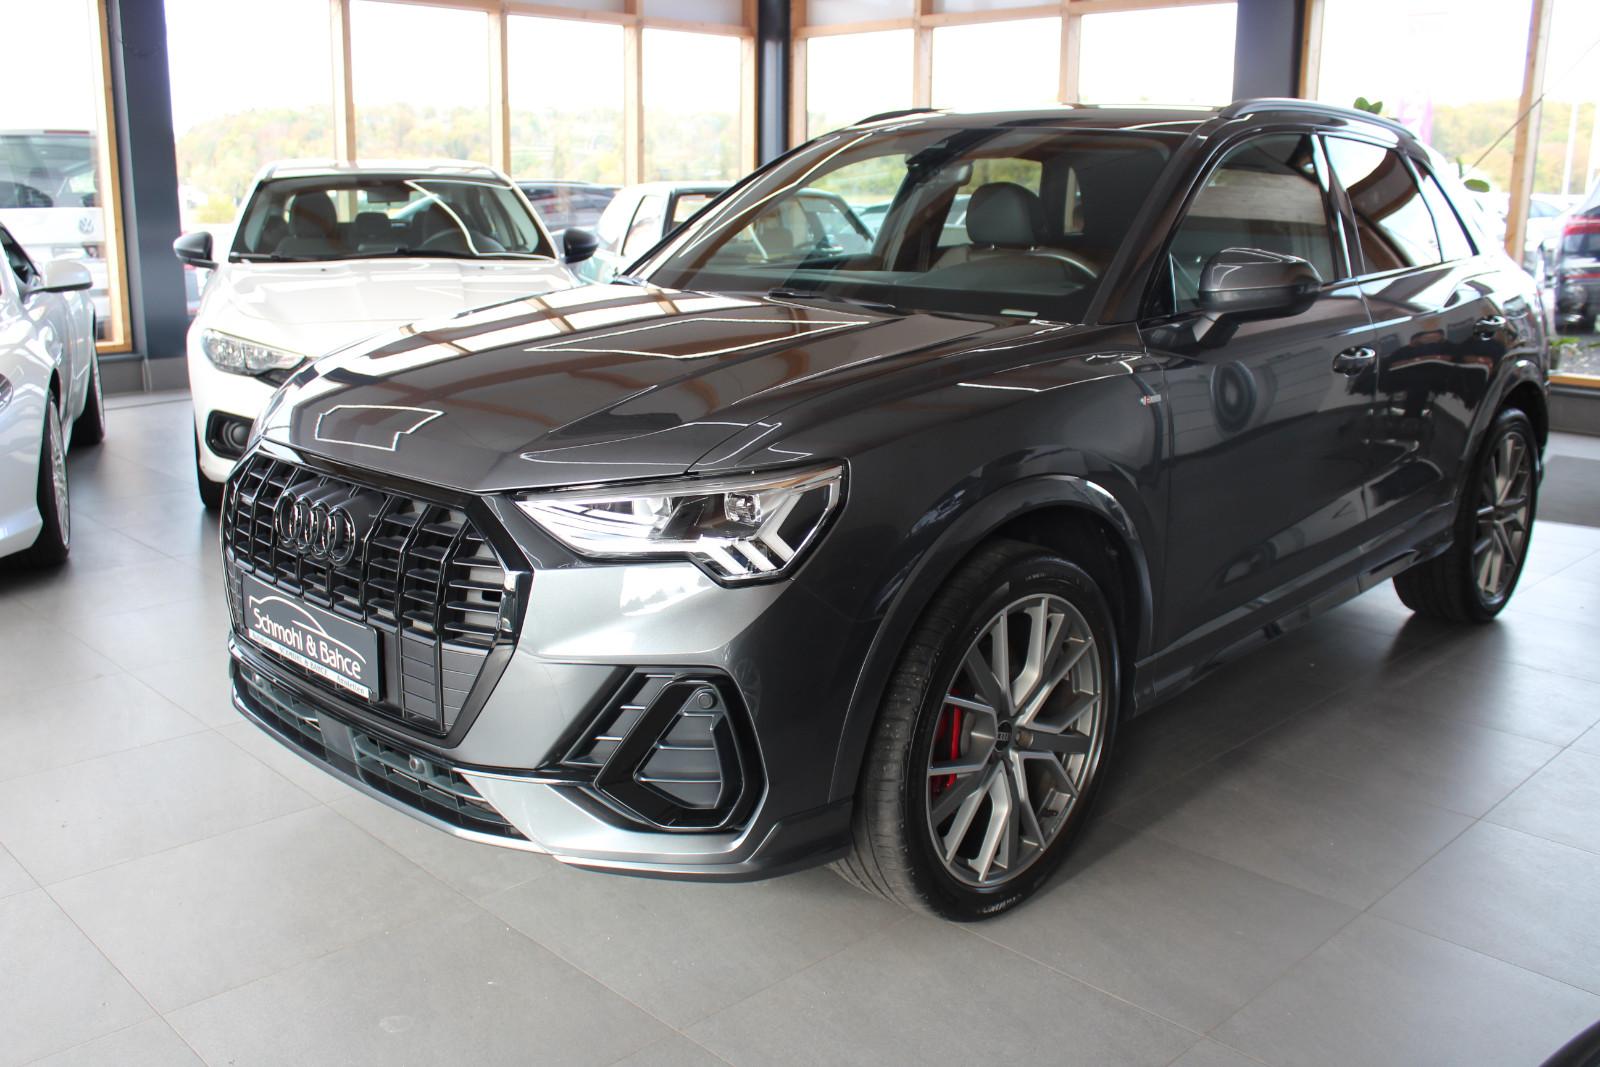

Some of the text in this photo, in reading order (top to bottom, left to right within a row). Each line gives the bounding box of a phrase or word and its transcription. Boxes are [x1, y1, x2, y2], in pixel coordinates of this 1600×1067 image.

[254, 607, 303, 651] Schmohl
[306, 634, 318, 658] &
[319, 641, 361, 679] Bahce
